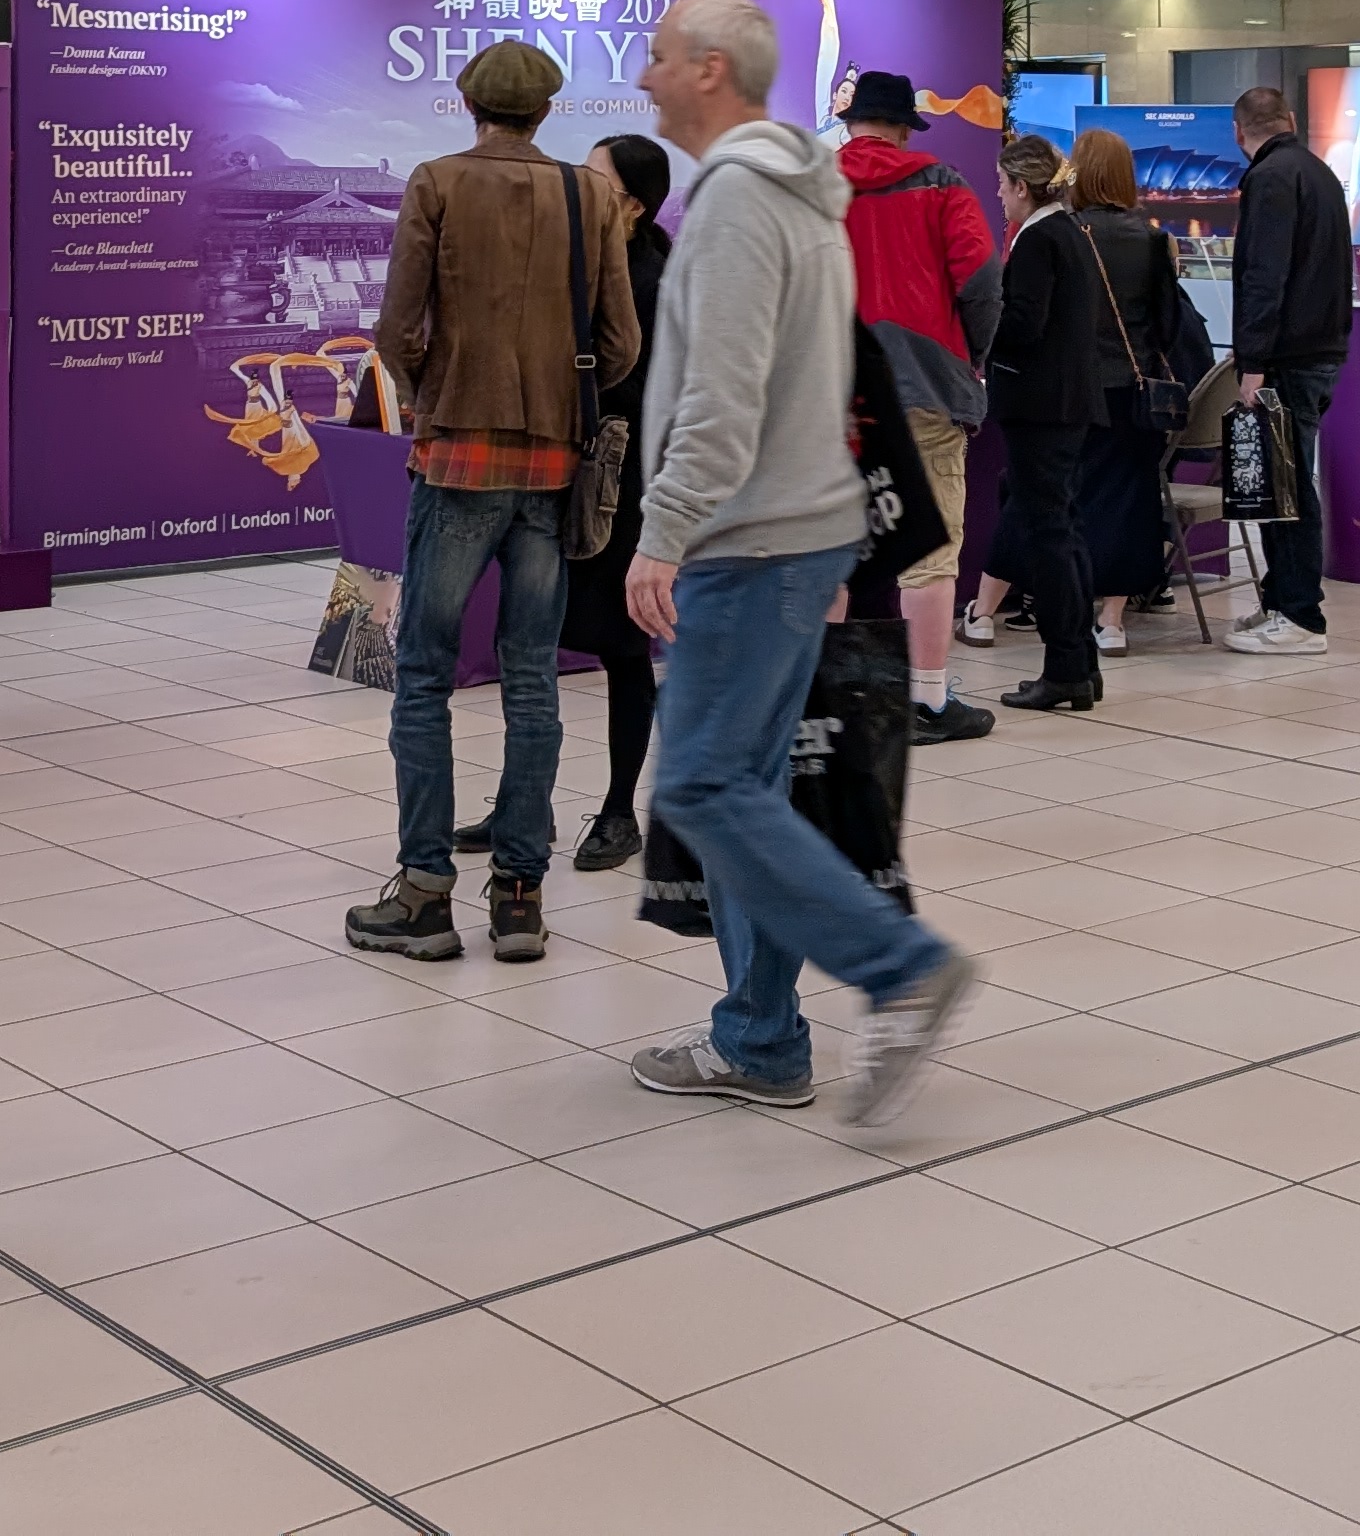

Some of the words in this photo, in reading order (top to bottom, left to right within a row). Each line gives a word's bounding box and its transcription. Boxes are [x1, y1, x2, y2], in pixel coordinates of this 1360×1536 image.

[107, 46, 146, 60] Karan
[387, 25, 578, 83] SHN
[49, 63, 88, 75] Fashion
[88, 64, 128, 77] designer
[128, 65, 167, 77] (DKNY)
[1158, 112, 1195, 121] ARMADILLO
[51, 188, 76, 204] An
[79, 186, 187, 205] extraordinary
[96, 240, 154, 255] Blanchett
[50, 262, 95, 273] Academy
[167, 258, 199, 270] actress
[127, 350, 165, 364] World
[43, 524, 146, 548] Birmingham
[160, 515, 218, 537] Oxford
[231, 509, 291, 531] London
